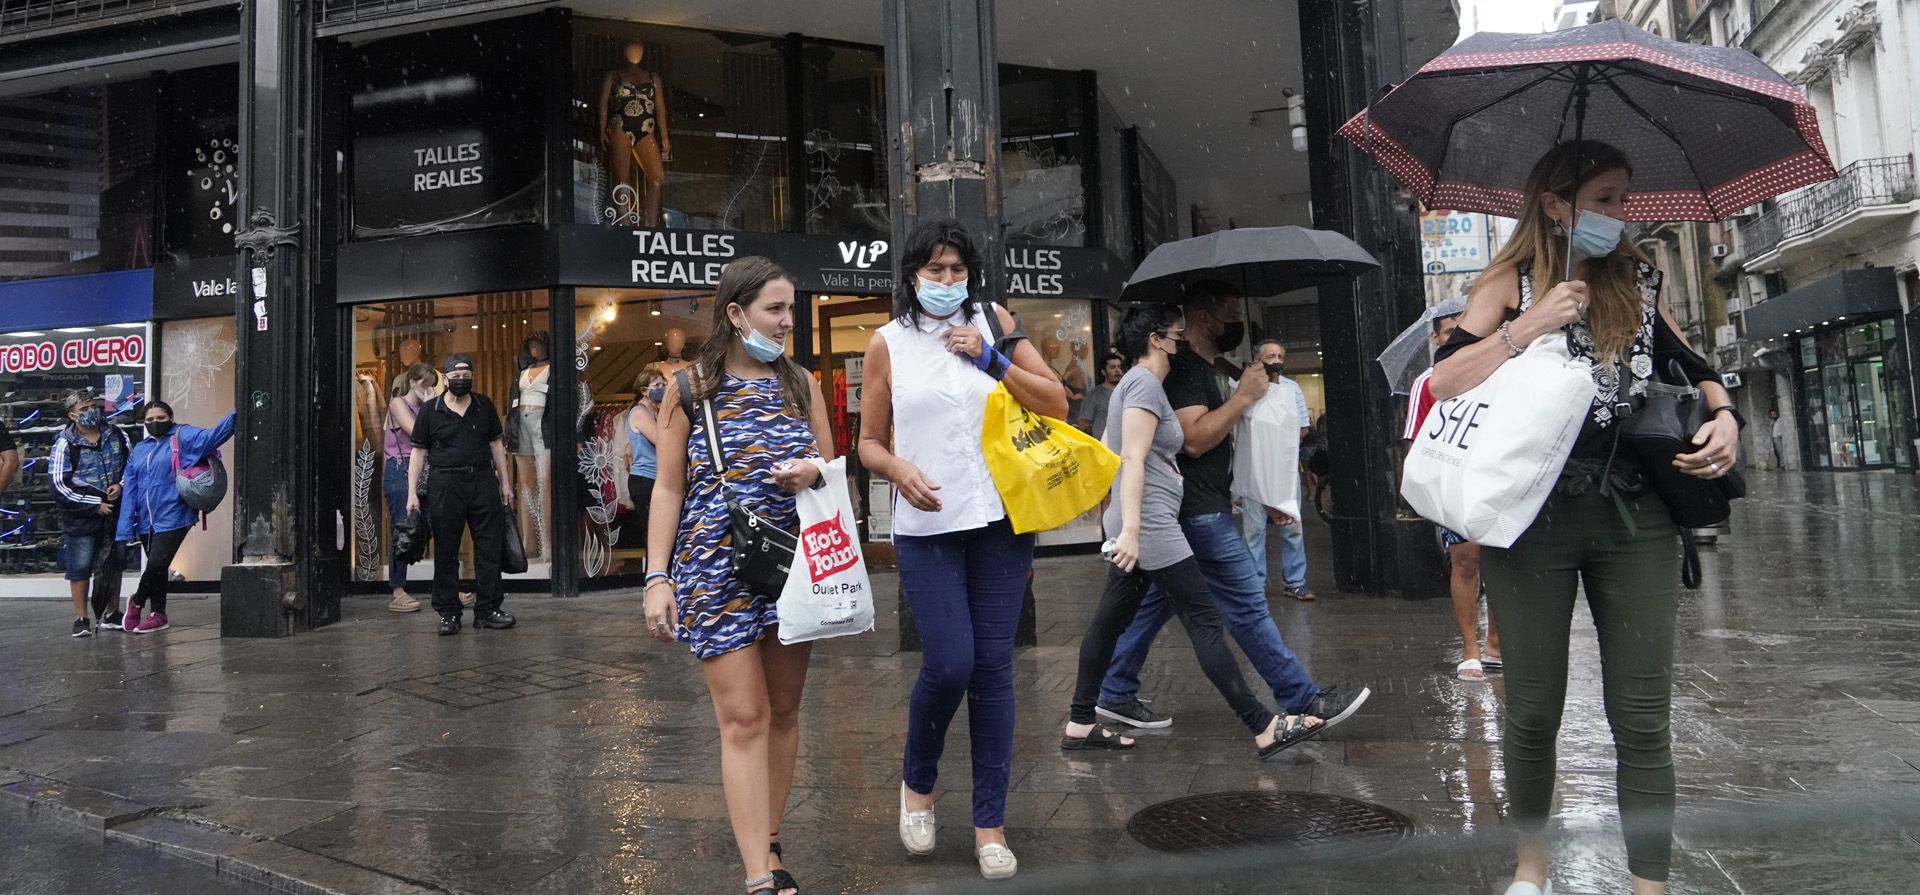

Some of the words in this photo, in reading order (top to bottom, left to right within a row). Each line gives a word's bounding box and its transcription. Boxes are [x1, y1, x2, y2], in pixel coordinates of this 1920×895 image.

[414, 142, 481, 167] TALLES
[414, 166, 484, 192] REALES
[632, 230, 735, 257] TALLES
[838, 240, 889, 269] VLP
[631, 259, 730, 285] REALE
[821, 273, 849, 287] Vale
[853, 273, 865, 287] la
[1006, 273, 1064, 295] ALES
[192, 280, 224, 298] Vale
[0, 341, 57, 373] TODO
[61, 335, 144, 369] CUERO
[1429, 397, 1490, 450] SHE
[804, 526, 843, 556] Hot
[812, 584, 838, 595] Ouet
[841, 581, 863, 595] Park
